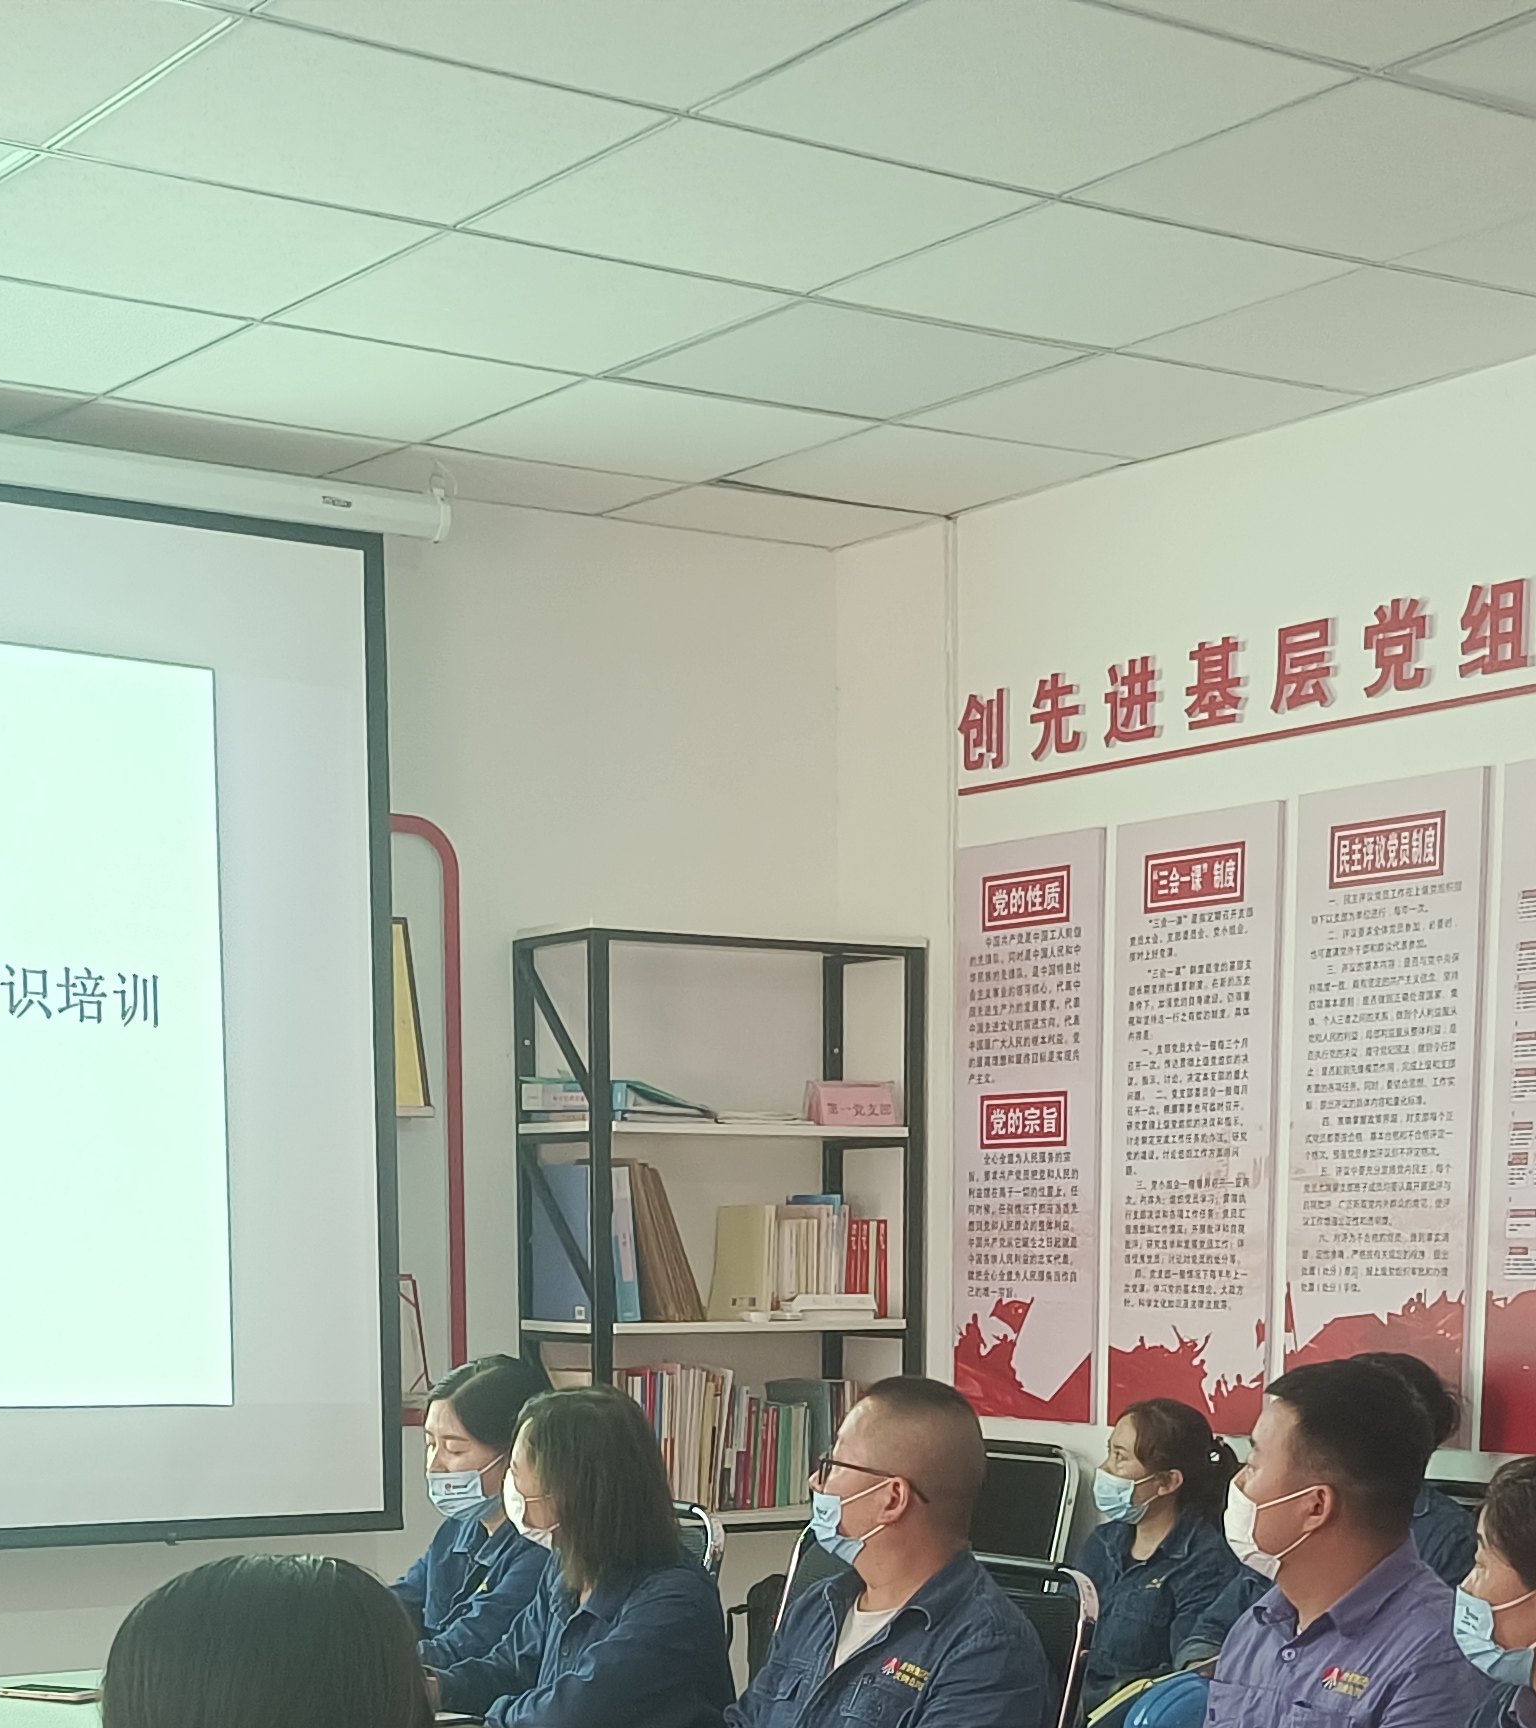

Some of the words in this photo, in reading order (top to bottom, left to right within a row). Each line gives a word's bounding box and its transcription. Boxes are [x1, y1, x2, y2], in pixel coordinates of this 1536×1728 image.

[1339, 826, 1436, 874] 民主评议党员制度
[992, 882, 1061, 917] 党的性质
[991, 1106, 1058, 1135] 党的宗旨
